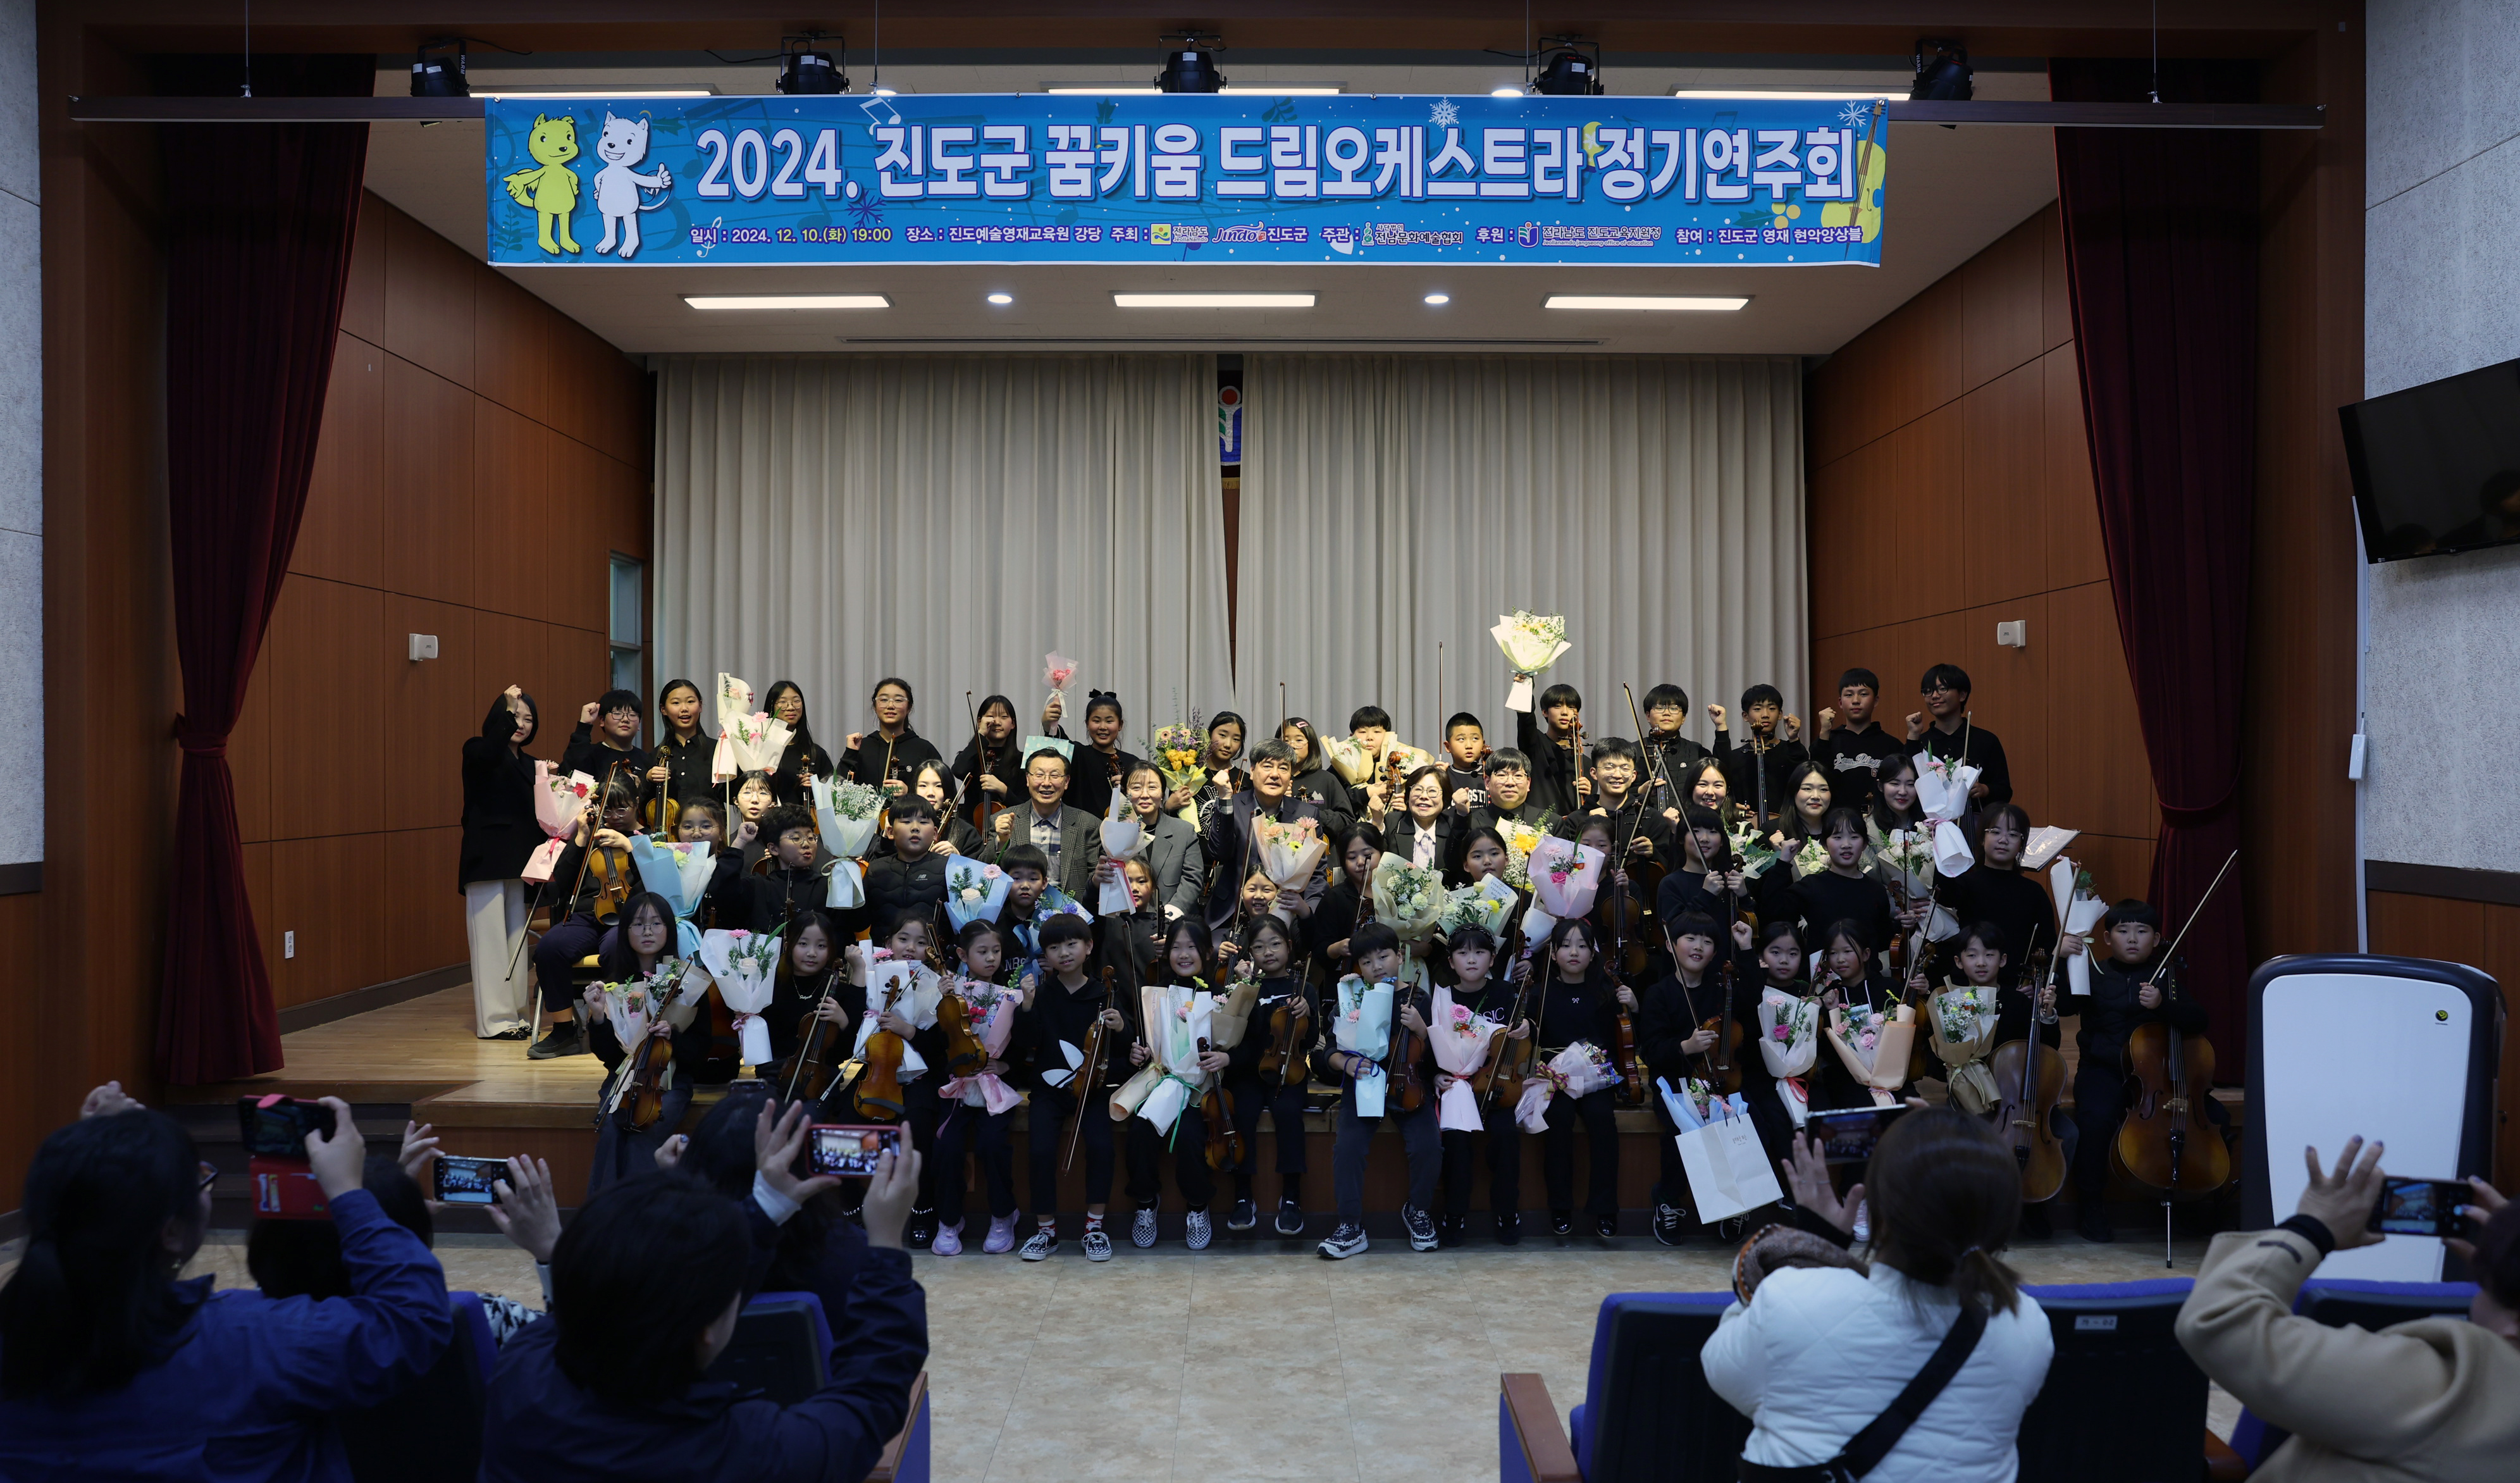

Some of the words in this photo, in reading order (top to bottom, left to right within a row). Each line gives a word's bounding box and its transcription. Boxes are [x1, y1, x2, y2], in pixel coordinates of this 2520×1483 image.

[696, 128, 858, 198] 2024.
[874, 125, 1030, 197] 진도군
[1045, 123, 1201, 197] 꿈키움
[1596, 126, 1853, 200] 정기연주회
[690, 228, 717, 243] 일시
[732, 228, 771, 242] 2024.
[777, 228, 796, 242] 12.
[802, 228, 847, 243] 10.(화)
[852, 228, 892, 242] 19:00
[906, 227, 934, 242] 장소
[949, 226, 1070, 242] 진도예술영재교육원
[1075, 226, 1101, 242] 강당
[1111, 226, 1138, 242] 주최
[1173, 226, 1209, 236] 전라남도
[1267, 226, 1308, 242] 진도군
[1322, 227, 1350, 242] 주관
[1376, 232, 1463, 244] 전남문화예술협회
[1476, 228, 1504, 242] 후원
[1542, 226, 1584, 239] 전라남도
[1588, 226, 1662, 239] 진도교육지원청
[1676, 228, 1703, 244] 참여
[1718, 228, 1758, 243] 진도군
[1762, 228, 1789, 244] 영재
[1793, 226, 1862, 243] 현악앙상블
